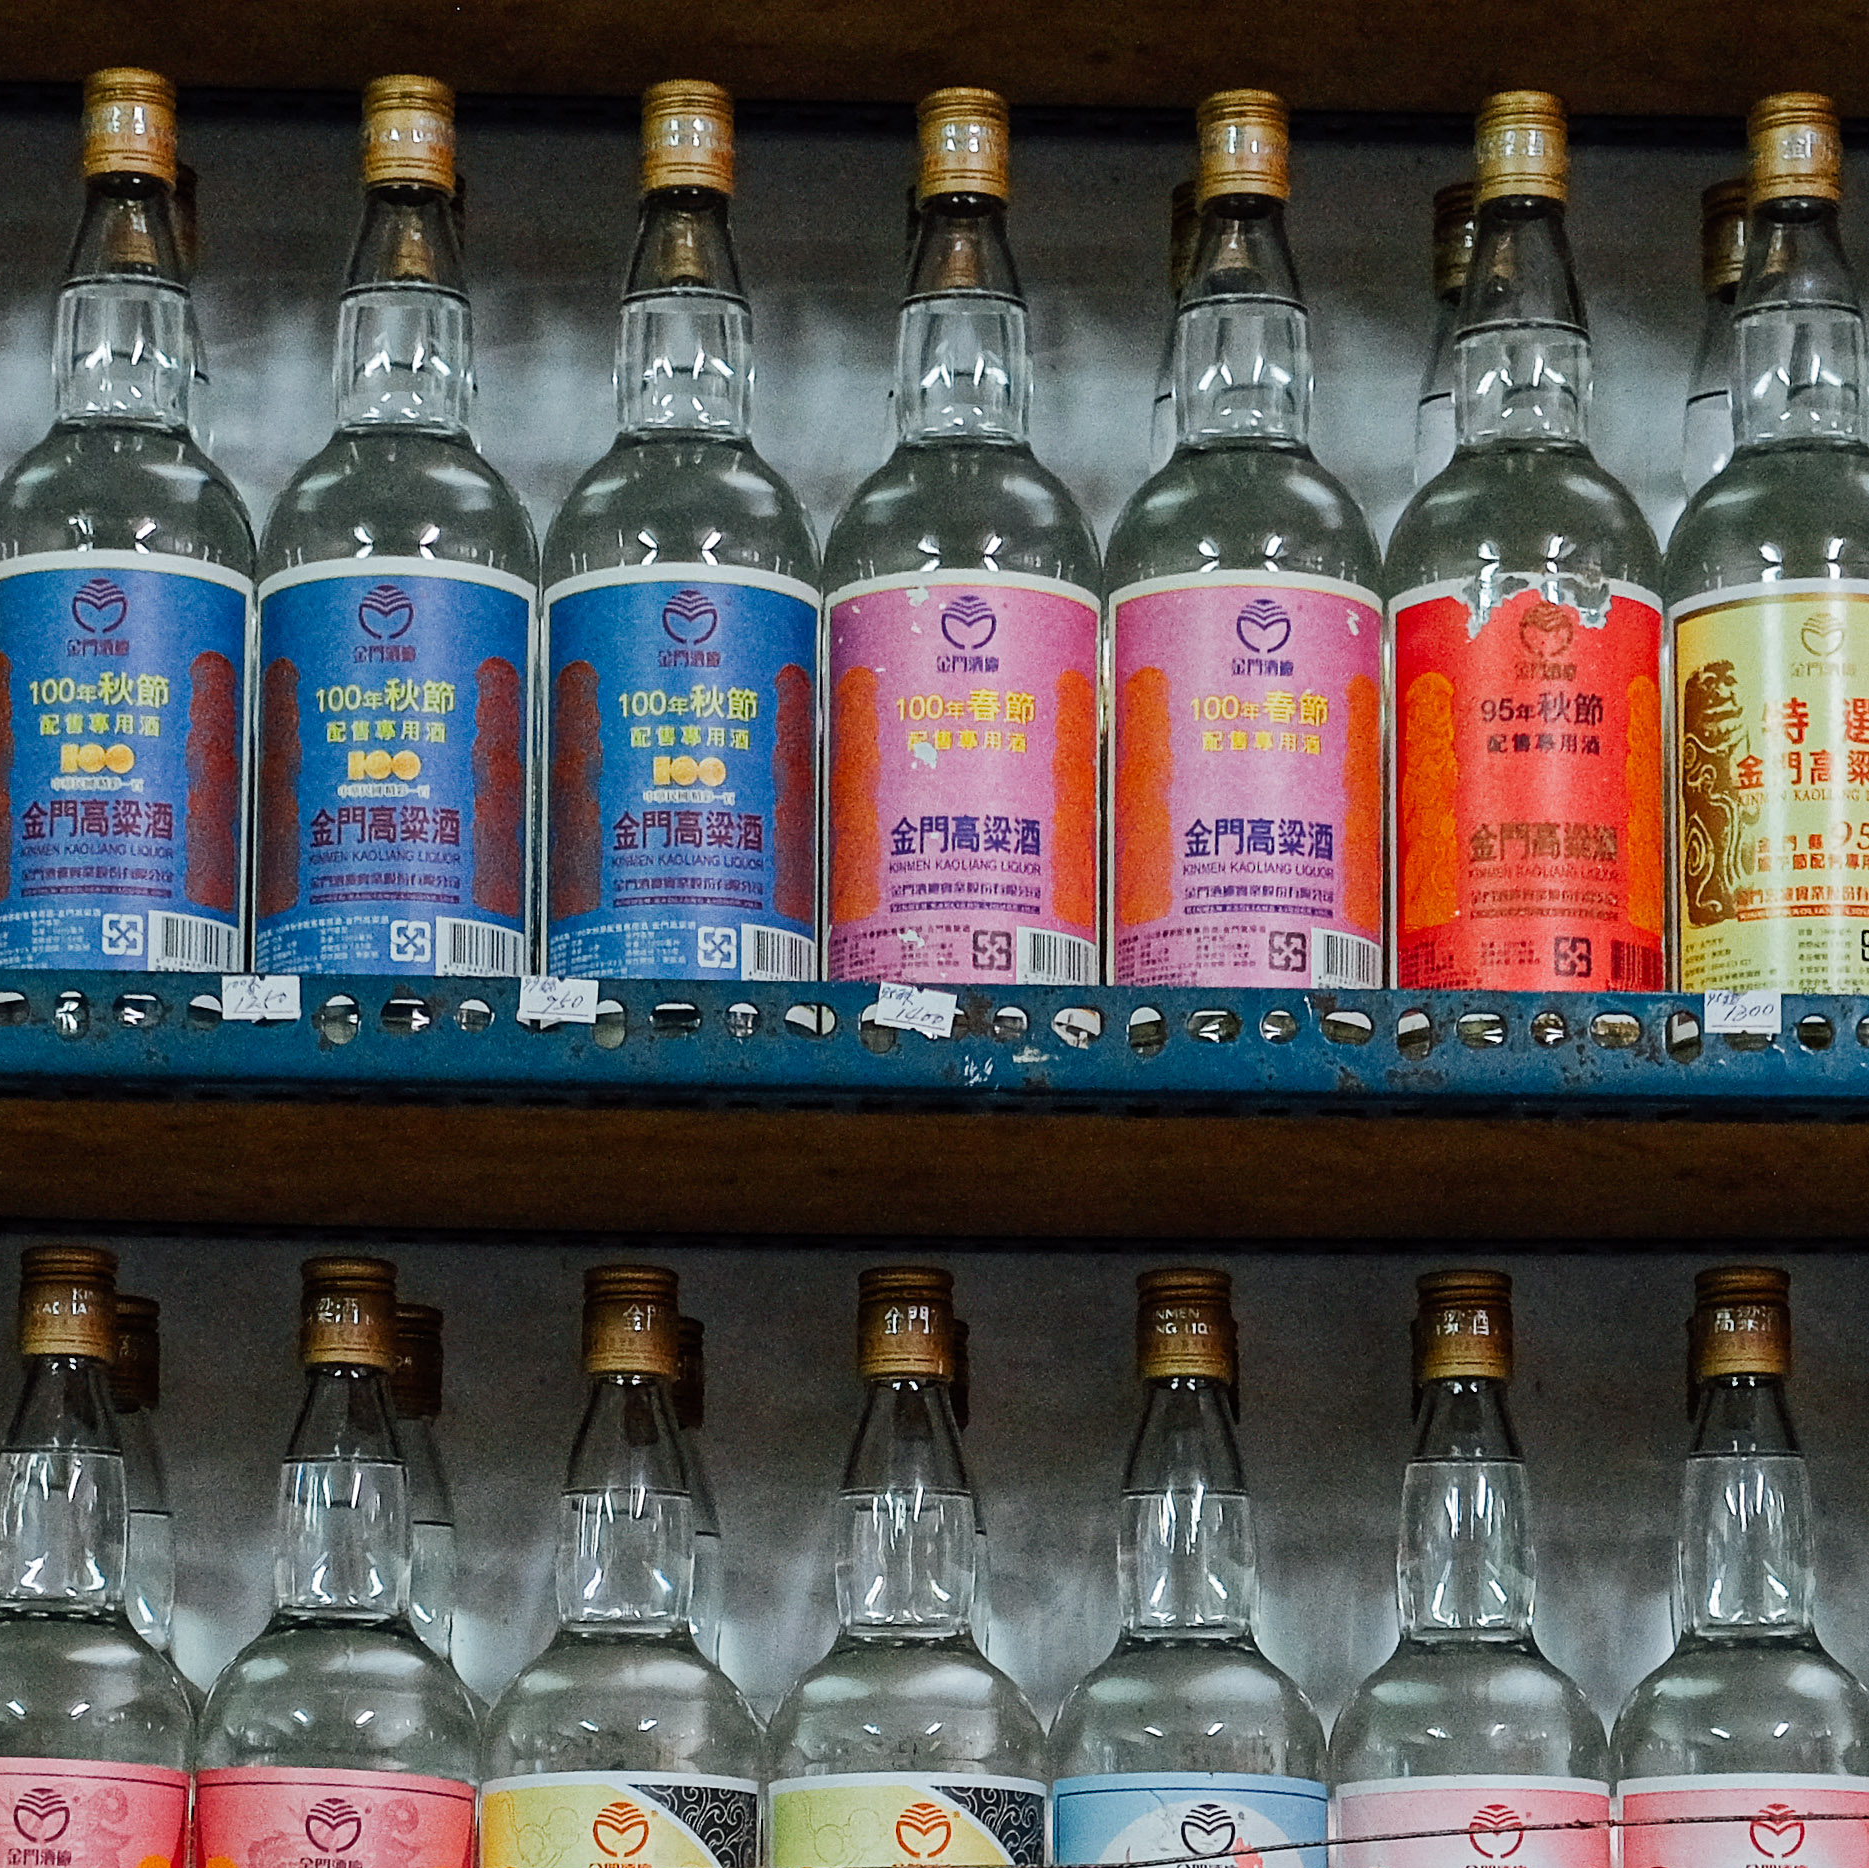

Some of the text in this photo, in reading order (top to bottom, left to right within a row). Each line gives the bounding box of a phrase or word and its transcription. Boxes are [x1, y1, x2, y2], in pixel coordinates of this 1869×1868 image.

[30, 672, 170, 708] 100年秋節
[316, 679, 455, 713] 100年秋節
[619, 686, 758, 720] 100年秋節
[896, 690, 1035, 722] 100年春節
[1190, 689, 1328, 725] 100年春節
[21, 800, 173, 841] 金門高粱酒
[310, 806, 461, 847] 金門高粱酒
[612, 811, 763, 851] 金門高粱酒
[891, 815, 1041, 855] 金門高粱酒
[1184, 818, 1333, 859] 金門高粱酒
[890, 859, 1041, 876] KINMEN KAOLIANG LIQUOR
